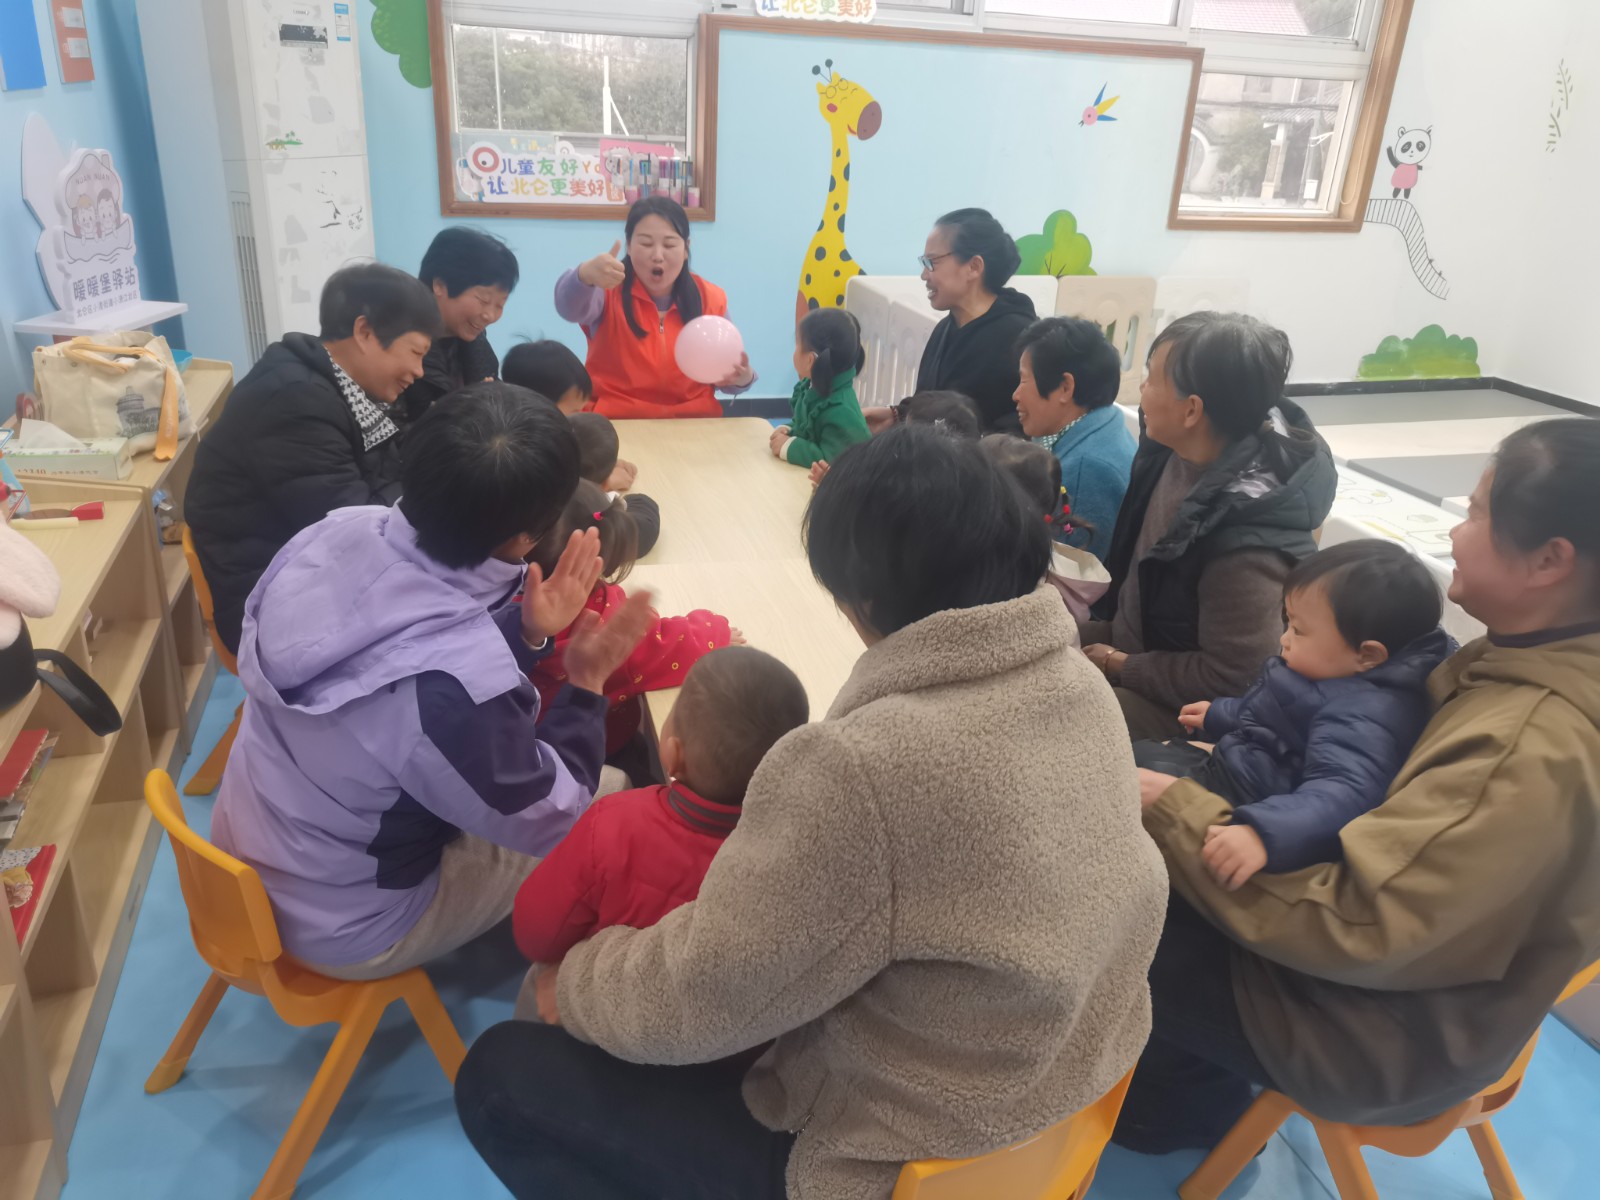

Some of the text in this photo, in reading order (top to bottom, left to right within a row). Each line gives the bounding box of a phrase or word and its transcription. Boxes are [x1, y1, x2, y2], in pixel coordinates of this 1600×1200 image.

[500, 157, 578, 176] 儿童友好
[487, 176, 604, 197] 让北仑更美好
[73, 266, 136, 301] 暖暖堡驿站
